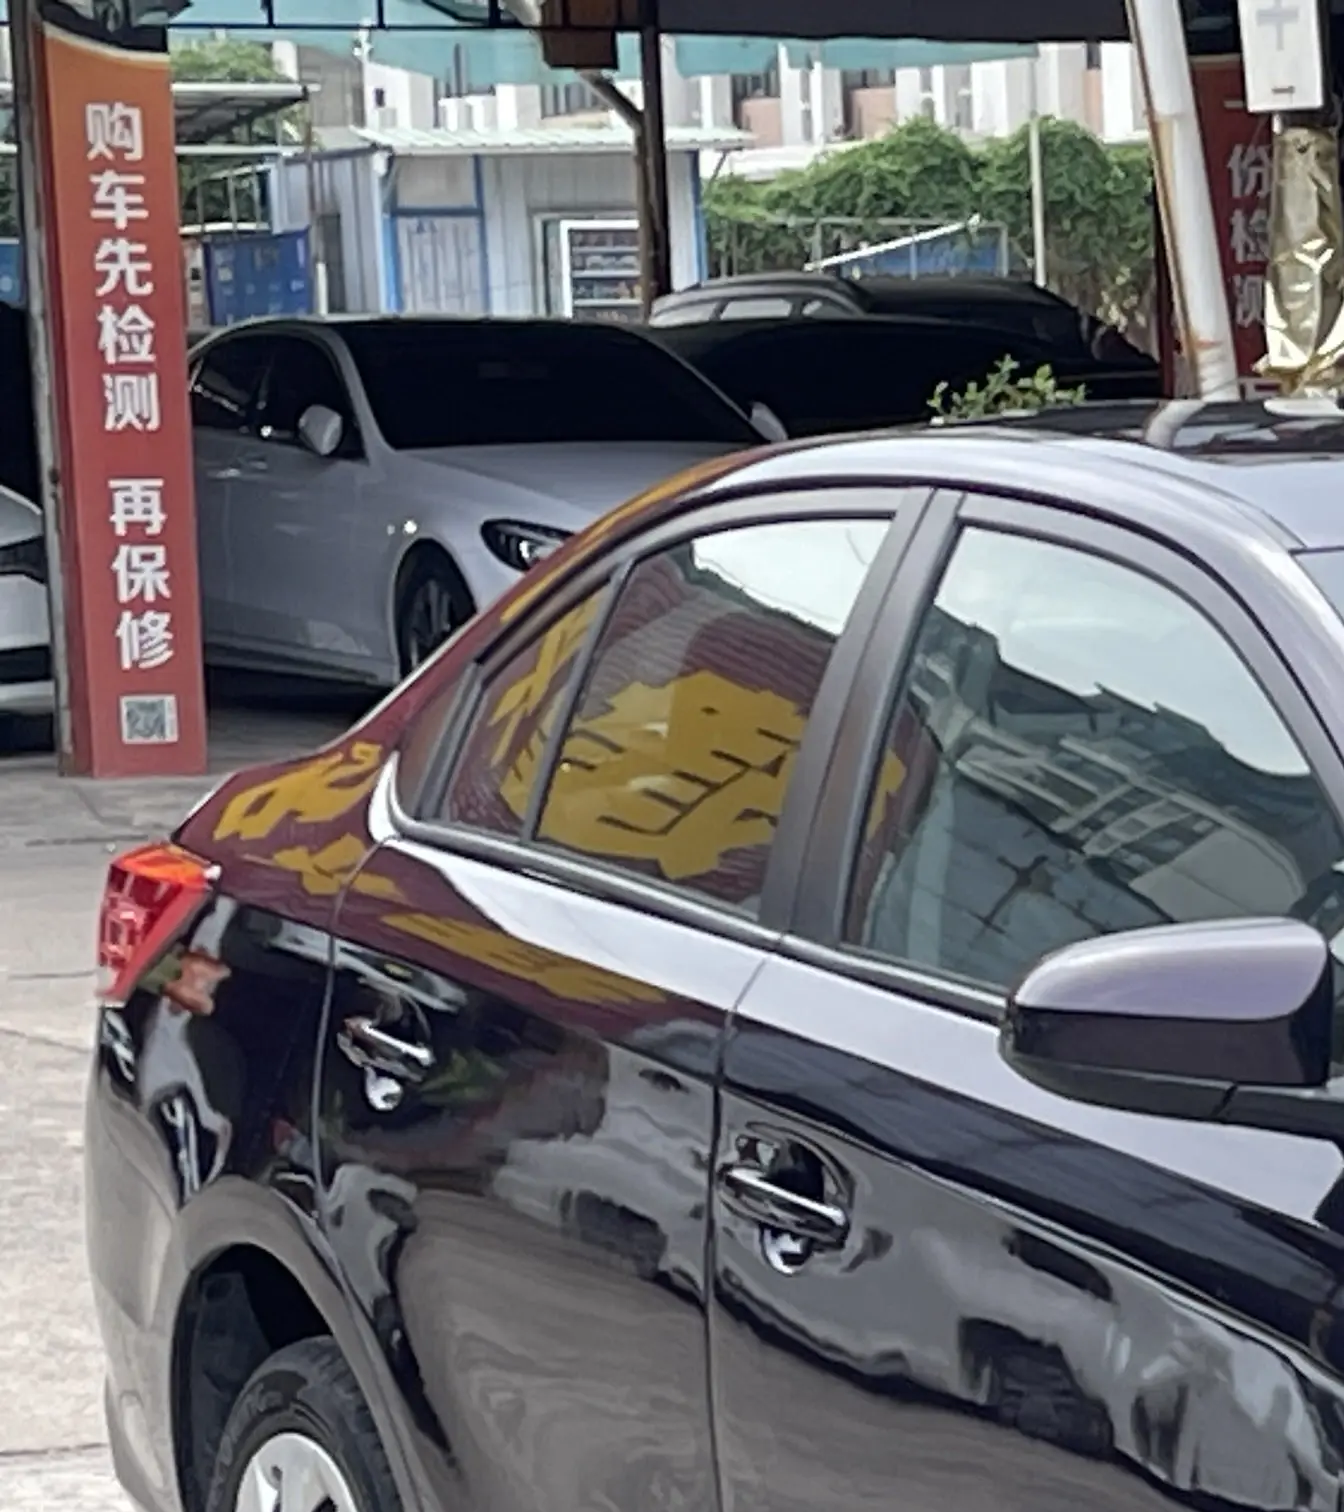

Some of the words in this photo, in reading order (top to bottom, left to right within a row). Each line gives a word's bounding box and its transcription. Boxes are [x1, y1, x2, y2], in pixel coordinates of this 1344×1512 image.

[85, 102, 161, 431] 购车先检测
[108, 478, 173, 670] 再保修
